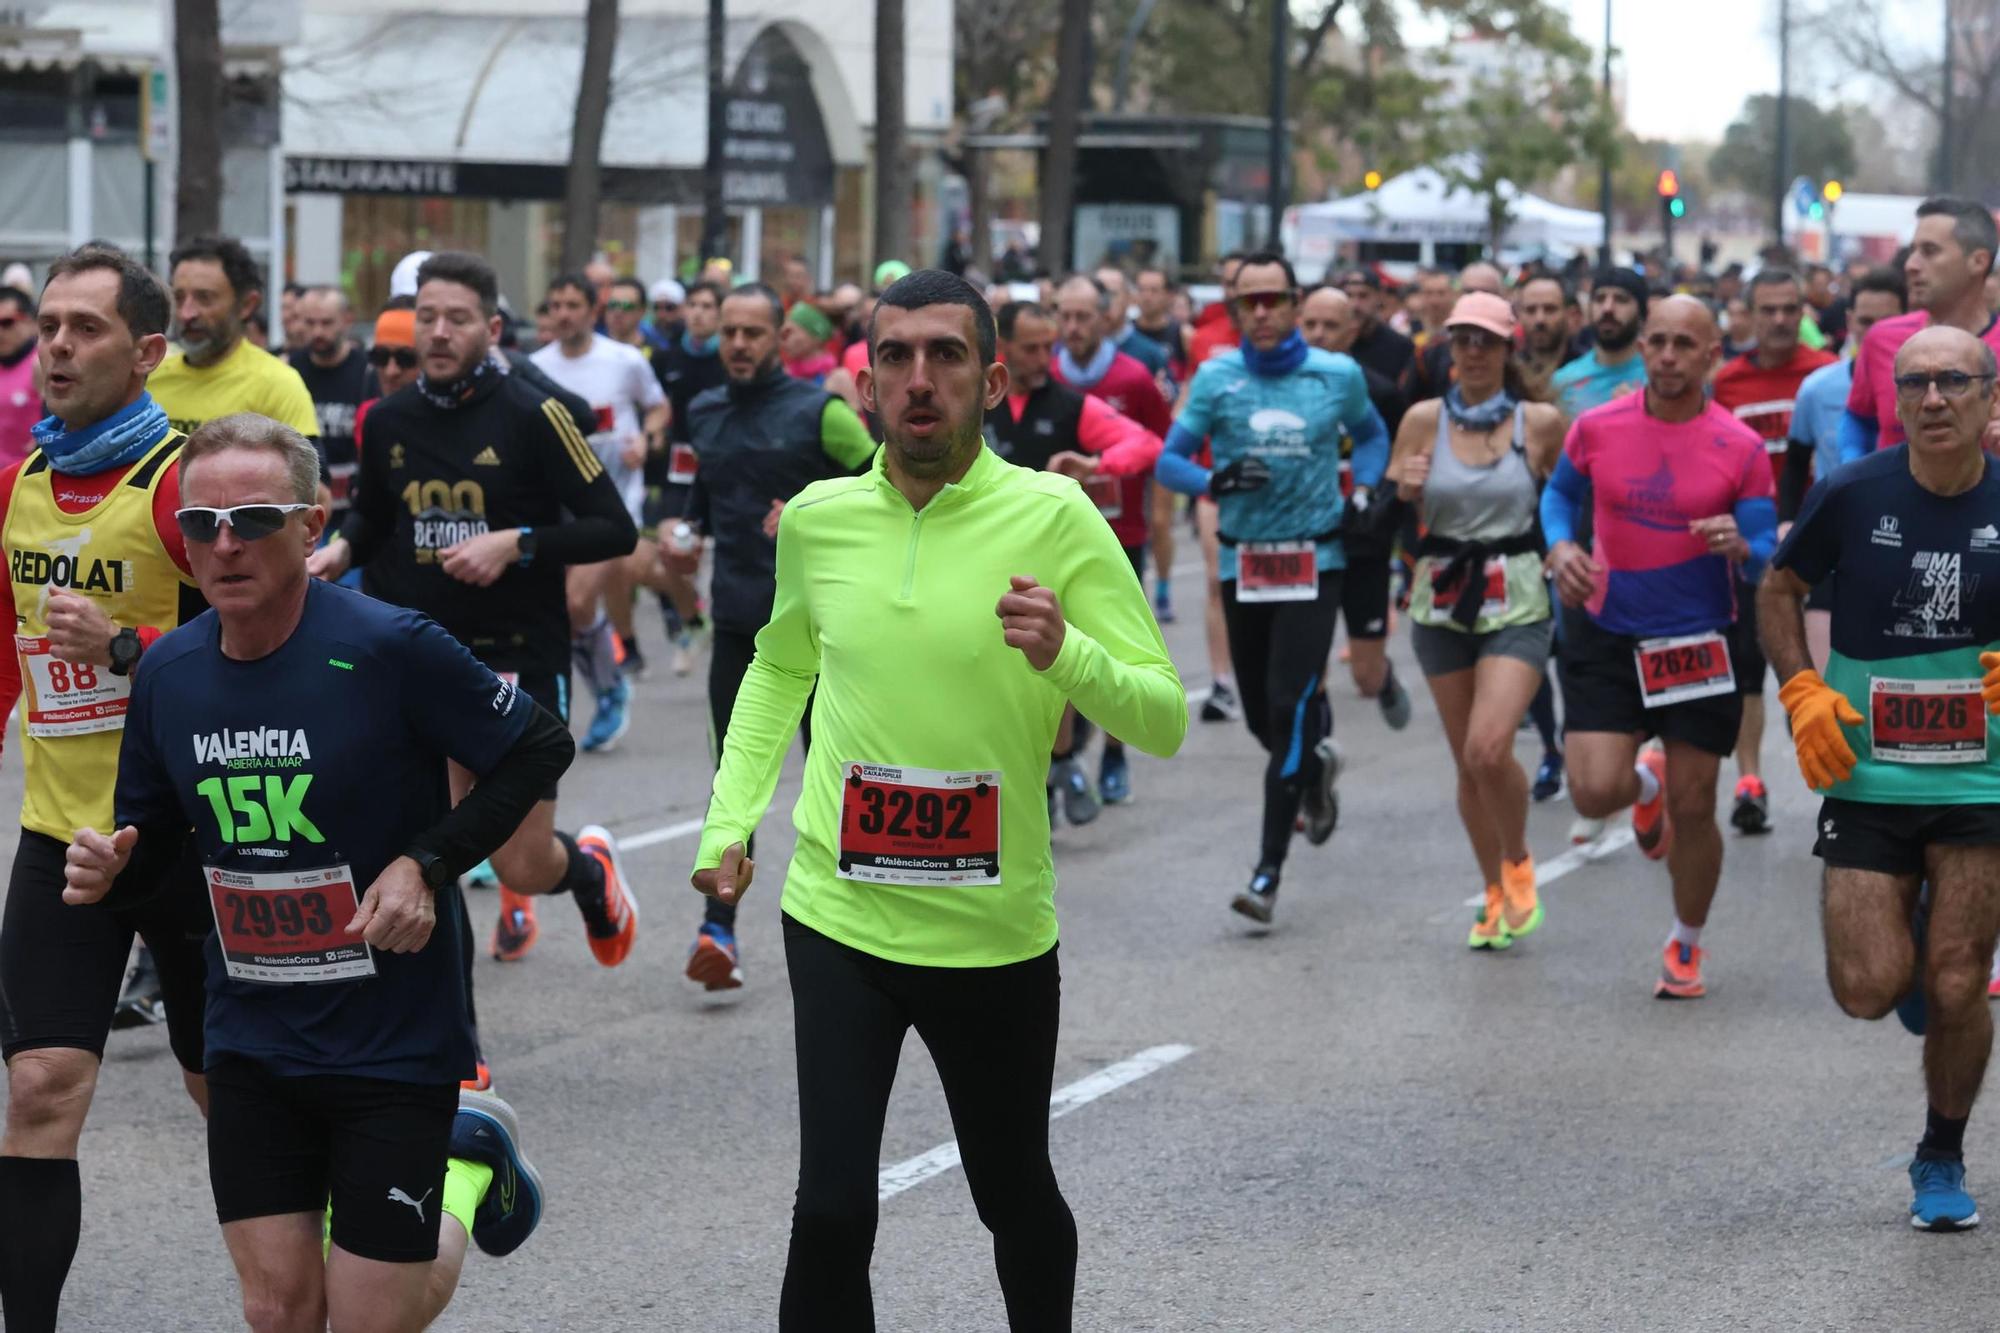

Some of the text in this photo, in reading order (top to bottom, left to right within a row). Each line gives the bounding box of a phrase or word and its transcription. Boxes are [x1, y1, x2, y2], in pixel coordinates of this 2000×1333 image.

[402, 479, 486, 517] 100
[48, 660, 97, 693] 88
[1884, 697, 1967, 730] 3026
[193, 725, 311, 765] VALENCIA
[227, 756, 302, 770] ABIERTA AL MAR
[196, 774, 326, 843] 15K
[859, 787, 972, 839] 3292
[237, 847, 290, 858] LAS PROVINCIAS
[874, 856, 950, 869] #ValènciaCorre
[224, 892, 333, 938] 2993
[254, 956, 320, 965] #ValènciaCorre
